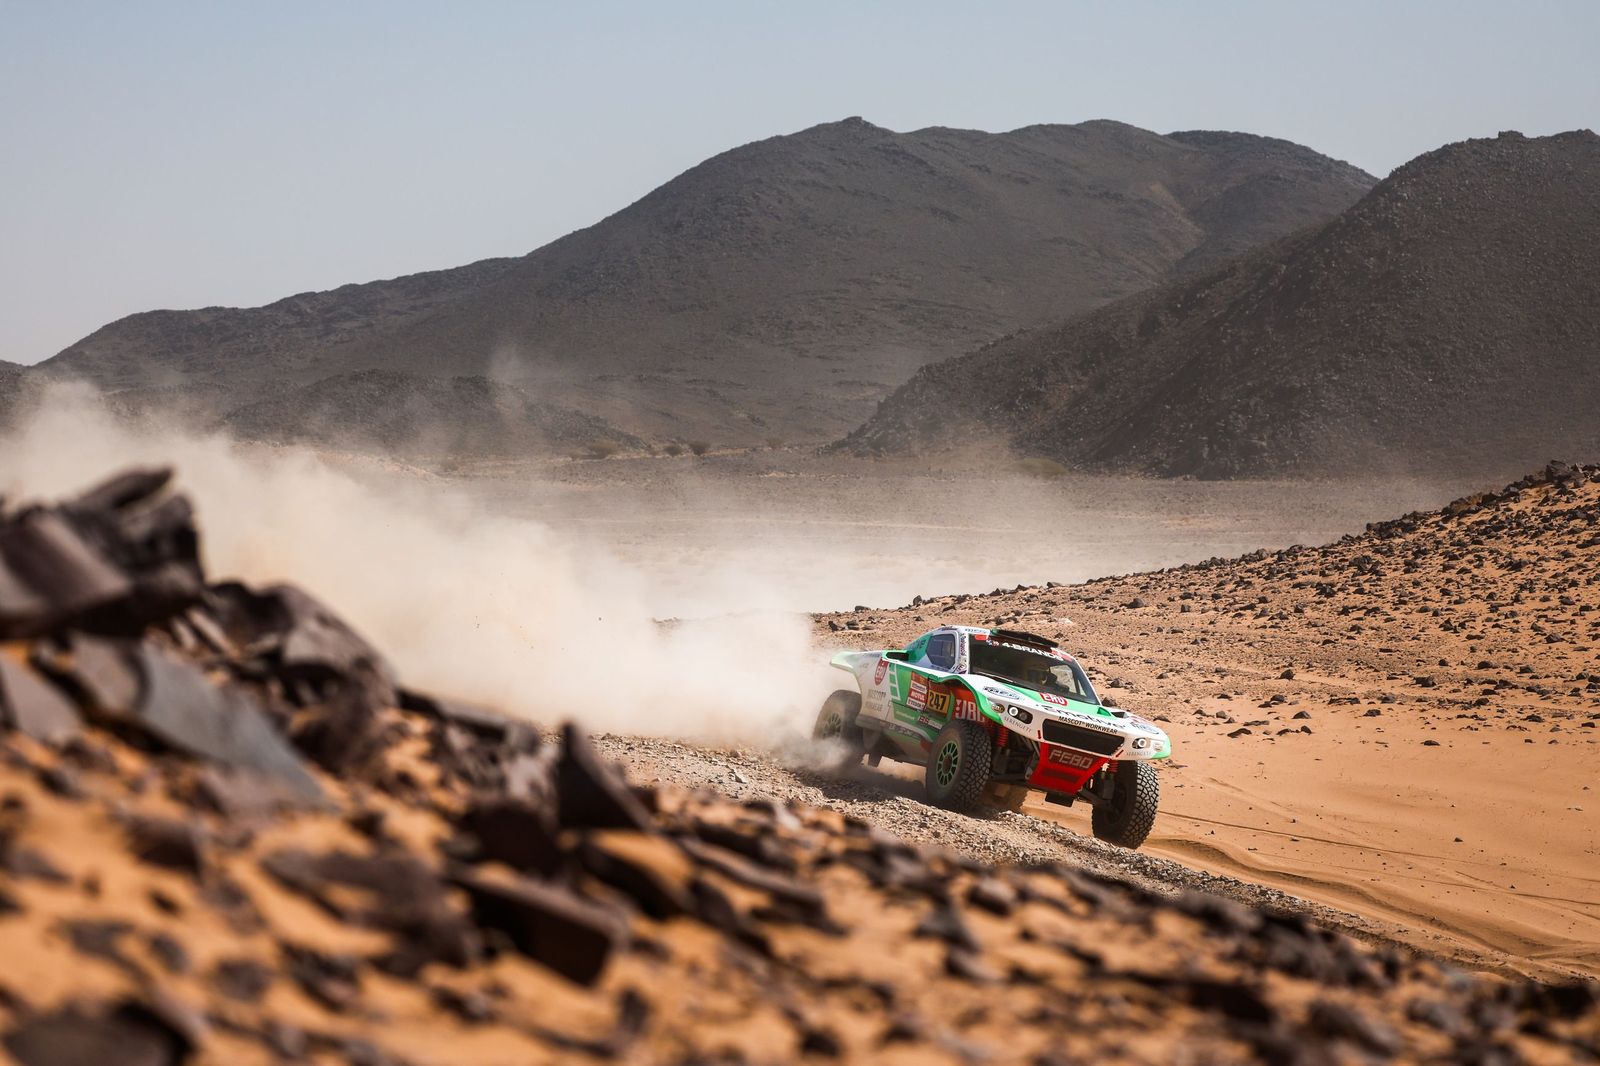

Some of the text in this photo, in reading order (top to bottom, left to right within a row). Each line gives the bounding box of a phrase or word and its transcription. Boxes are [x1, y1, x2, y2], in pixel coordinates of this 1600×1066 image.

[929, 692, 947, 711] 247
[1085, 723, 1118, 735] WORKWEAR
[1048, 749, 1094, 769] FEBO
